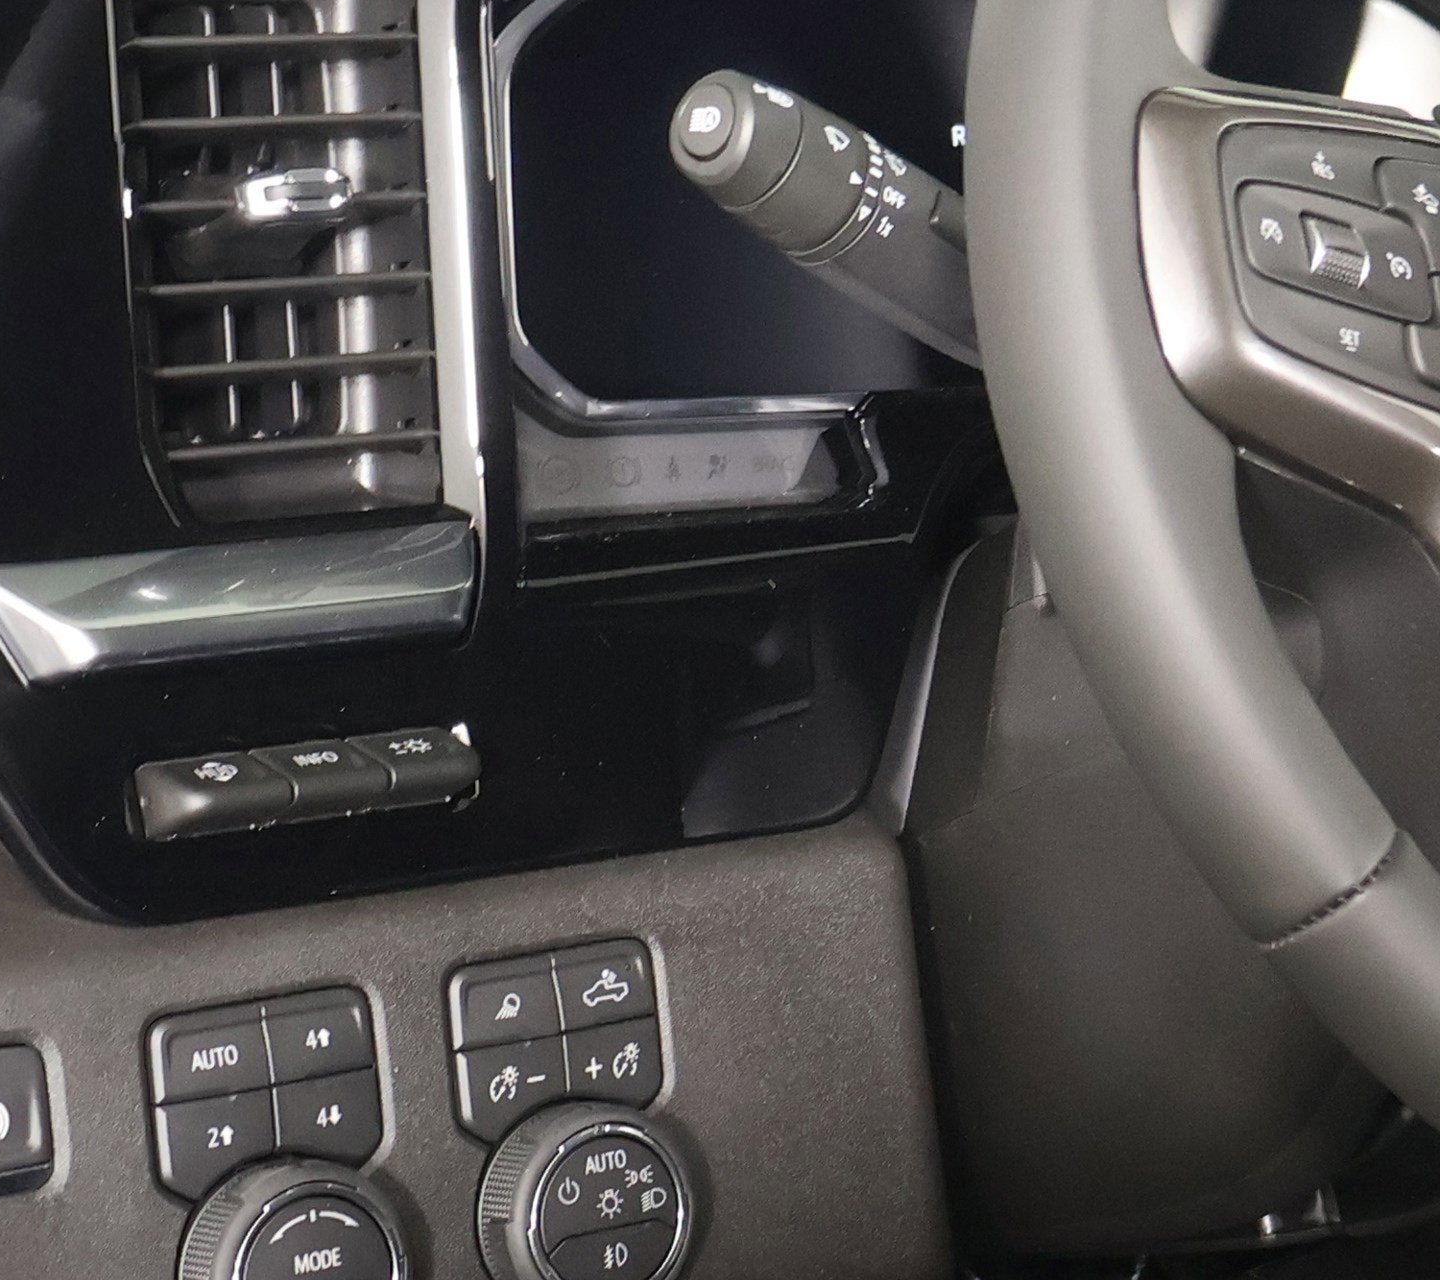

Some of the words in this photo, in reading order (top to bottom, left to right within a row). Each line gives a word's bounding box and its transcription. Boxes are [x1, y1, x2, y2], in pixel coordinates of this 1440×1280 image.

[883, 186, 906, 209] OFF
[876, 216, 894, 237] 1x
[1339, 327, 1360, 345] SET
[191, 1044, 238, 1072] AUTO
[585, 1149, 626, 1175] AUTO
[294, 1247, 341, 1275] MODE
